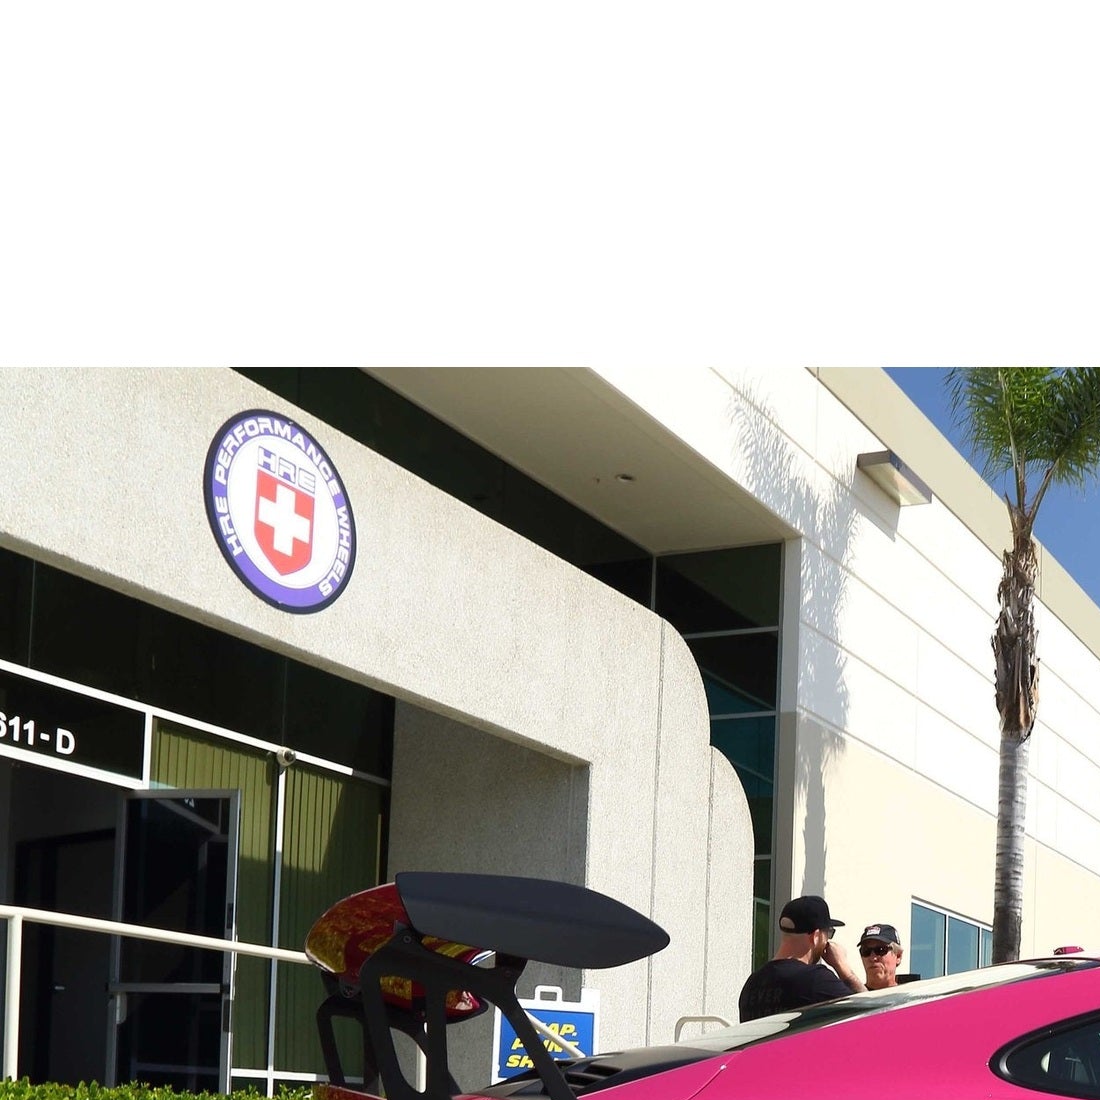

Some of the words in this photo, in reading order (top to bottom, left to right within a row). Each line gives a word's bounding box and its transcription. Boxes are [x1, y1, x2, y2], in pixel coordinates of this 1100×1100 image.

[215, 417, 341, 495] PERFORMANCE
[258, 446, 316, 495] HRE
[214, 496, 243, 557] HRE
[318, 504, 351, 597] WHEELS
